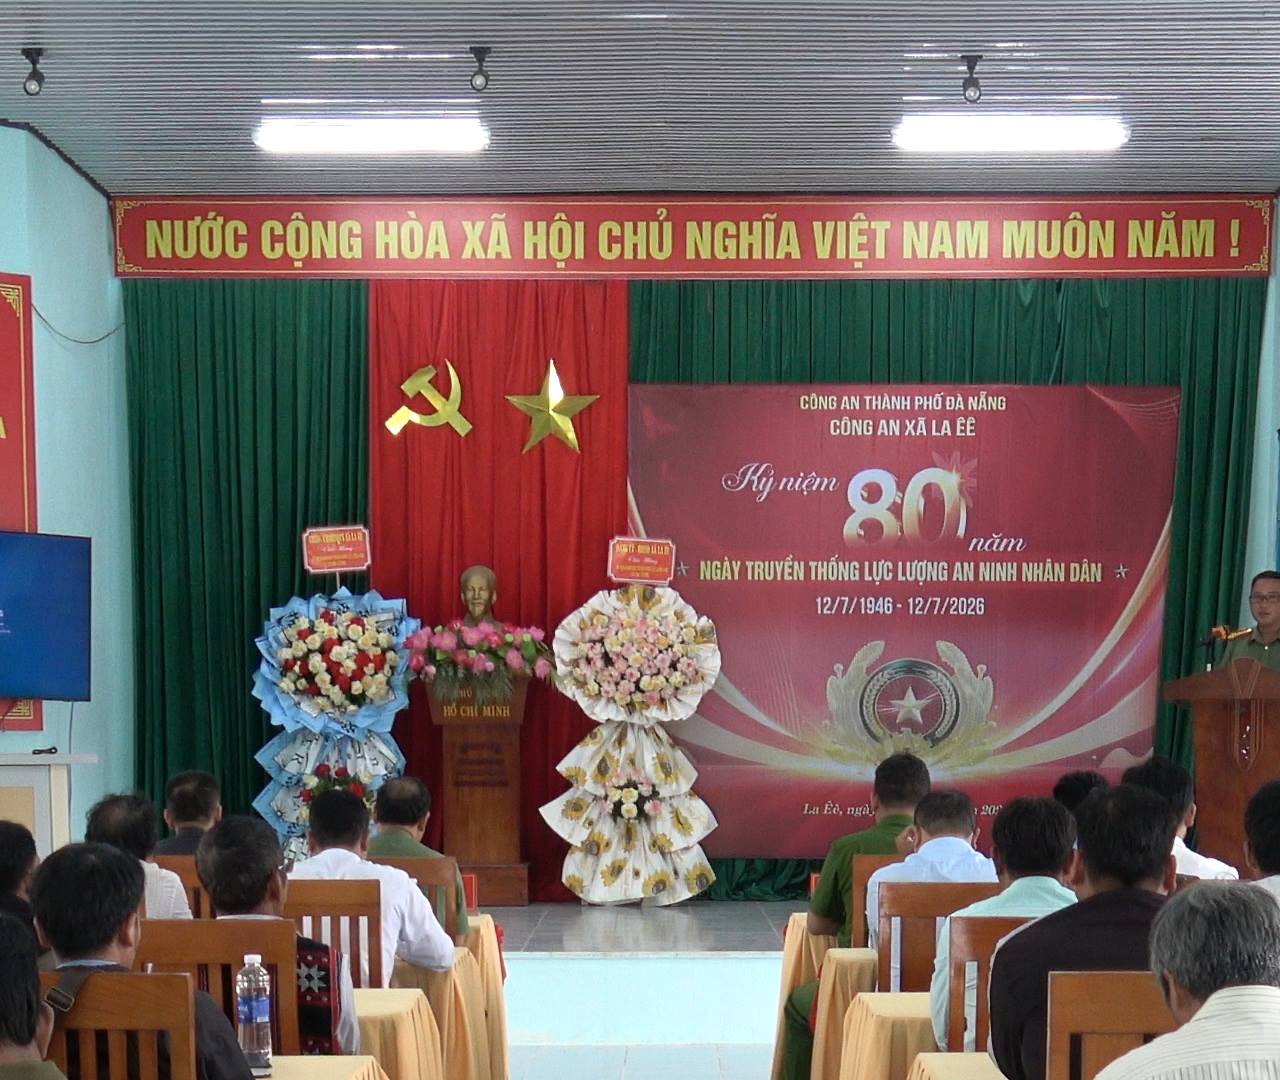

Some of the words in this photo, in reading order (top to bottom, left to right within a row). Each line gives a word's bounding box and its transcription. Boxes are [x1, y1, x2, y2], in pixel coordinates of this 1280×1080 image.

[147, 212, 247, 258] NƯỚC
[262, 213, 362, 267] CỘNG
[376, 211, 449, 259] HÒA
[462, 213, 511, 259] XÃ
[524, 213, 584, 268] HỘI
[599, 208, 672, 260] CHỦ
[687, 213, 800, 259] NGHĨA
[813, 213, 891, 268] VIỆT
[903, 221, 988, 258] NAM
[1002, 212, 1114, 259] MUÔN
[1128, 212, 1214, 257] NĂM
[1230, 219, 1239, 256] !
[801, 393, 837, 409] CÔNG
[841, 396, 859, 409] AN
[864, 394, 910, 410] THÀNH
[915, 392, 944, 410] PHỐ
[946, 394, 964, 410] ĐÀ
[968, 391, 1006, 410] NẴNG
[830, 417, 873, 435] CÔNG
[878, 420, 899, 435] AN
[905, 417, 926, 435] XÃ
[932, 420, 951, 435] LA
[956, 417, 975, 436] ÊÊ
[721, 463, 778, 502] Kỷ
[778, 472, 838, 495] niệm
[842, 466, 966, 547] 80
[969, 531, 1026, 552] năm
[699, 557, 740, 580] NGÀY
[746, 555, 804, 580] TRUYỀN
[809, 555, 859, 581] THỐNG
[865, 560, 892, 585] LỰC
[898, 560, 947, 585] LƯỢNG
[953, 562, 974, 581] AN
[979, 562, 1016, 581] NINH
[1022, 559, 1064, 582] NHÂN
[1070, 559, 1101, 582] DÂN
[816, 597, 892, 614] 12/7/1946
[908, 597, 984, 614] 12/7/2026
[803, 803, 819, 815] La
